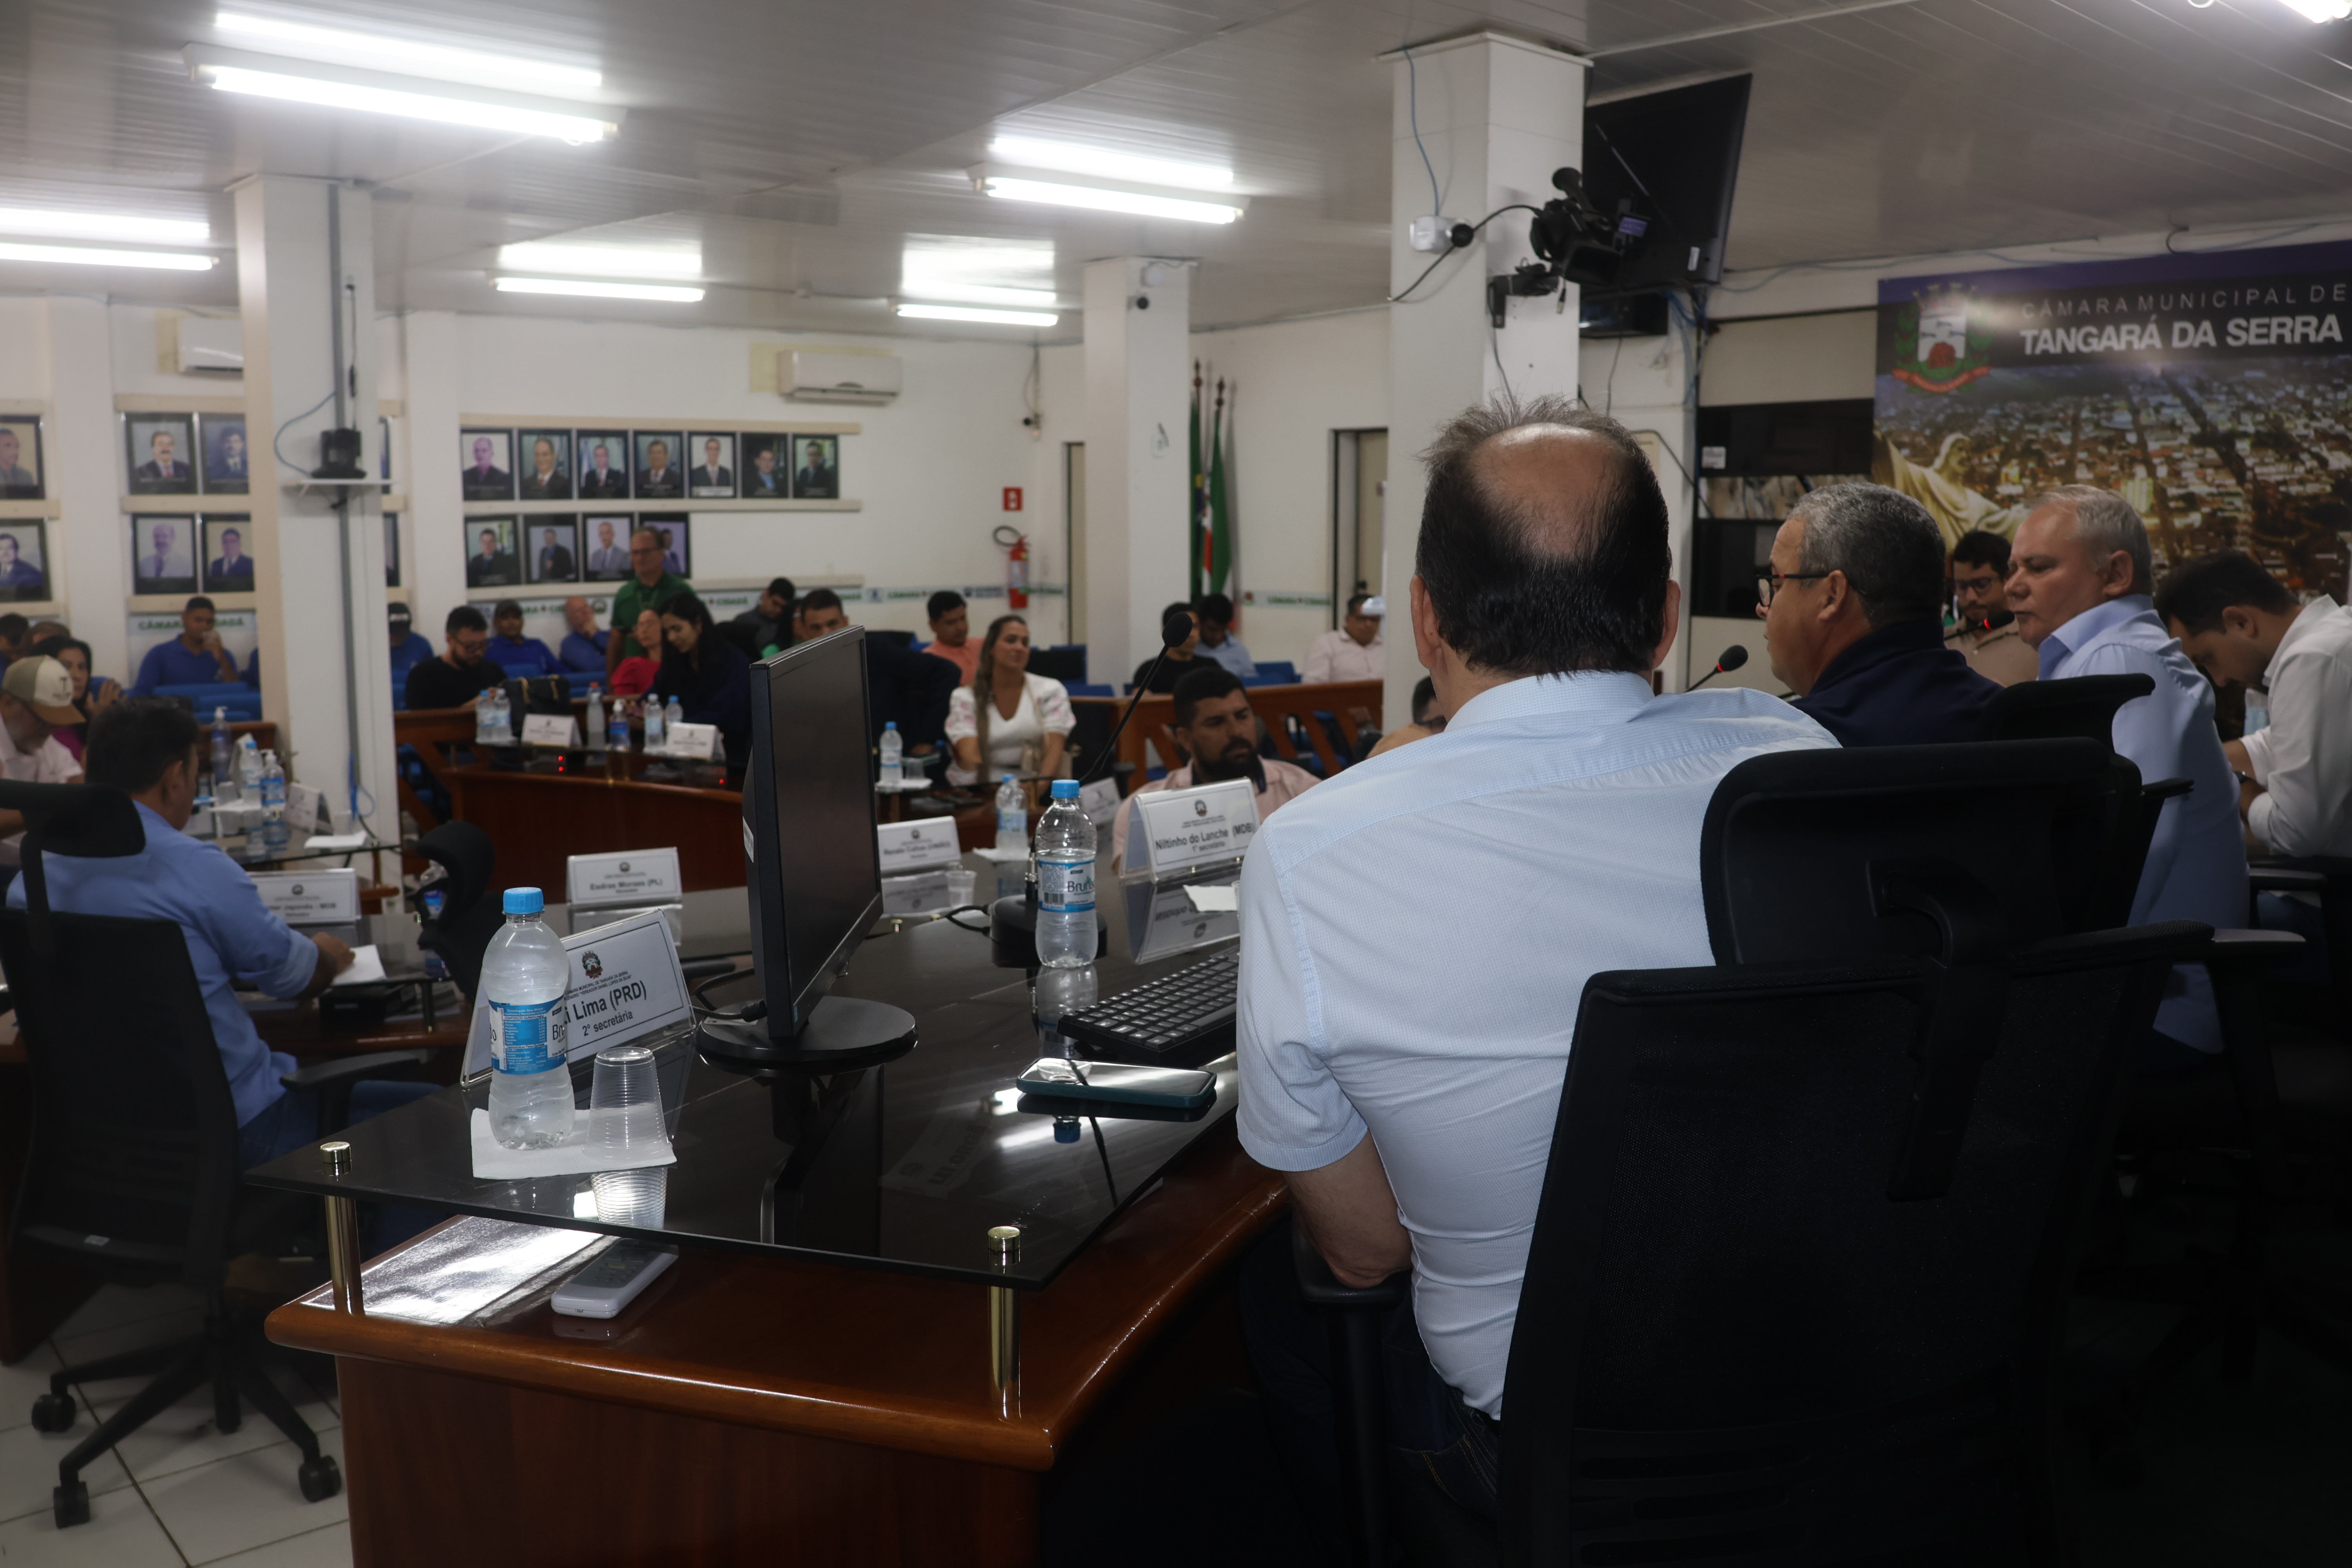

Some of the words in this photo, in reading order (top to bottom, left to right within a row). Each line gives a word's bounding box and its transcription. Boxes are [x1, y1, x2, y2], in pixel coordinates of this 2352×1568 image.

[2022, 297, 2129, 319] CÂMARA
[2138, 287, 2297, 311] MUNICIPAL
[2310, 283, 2347, 303] DE
[2020, 314, 2163, 356] TANGARÁ
[2171, 319, 2218, 349] DA
[2225, 314, 2344, 348] SERRA
[1155, 837, 1187, 849] Niltinho
[1189, 833, 1200, 844] do
[1201, 828, 1229, 842] Lanche
[573, 998, 607, 1021] Lima
[610, 980, 646, 1011] (PRD)
[593, 1010, 633, 1032] secretária
